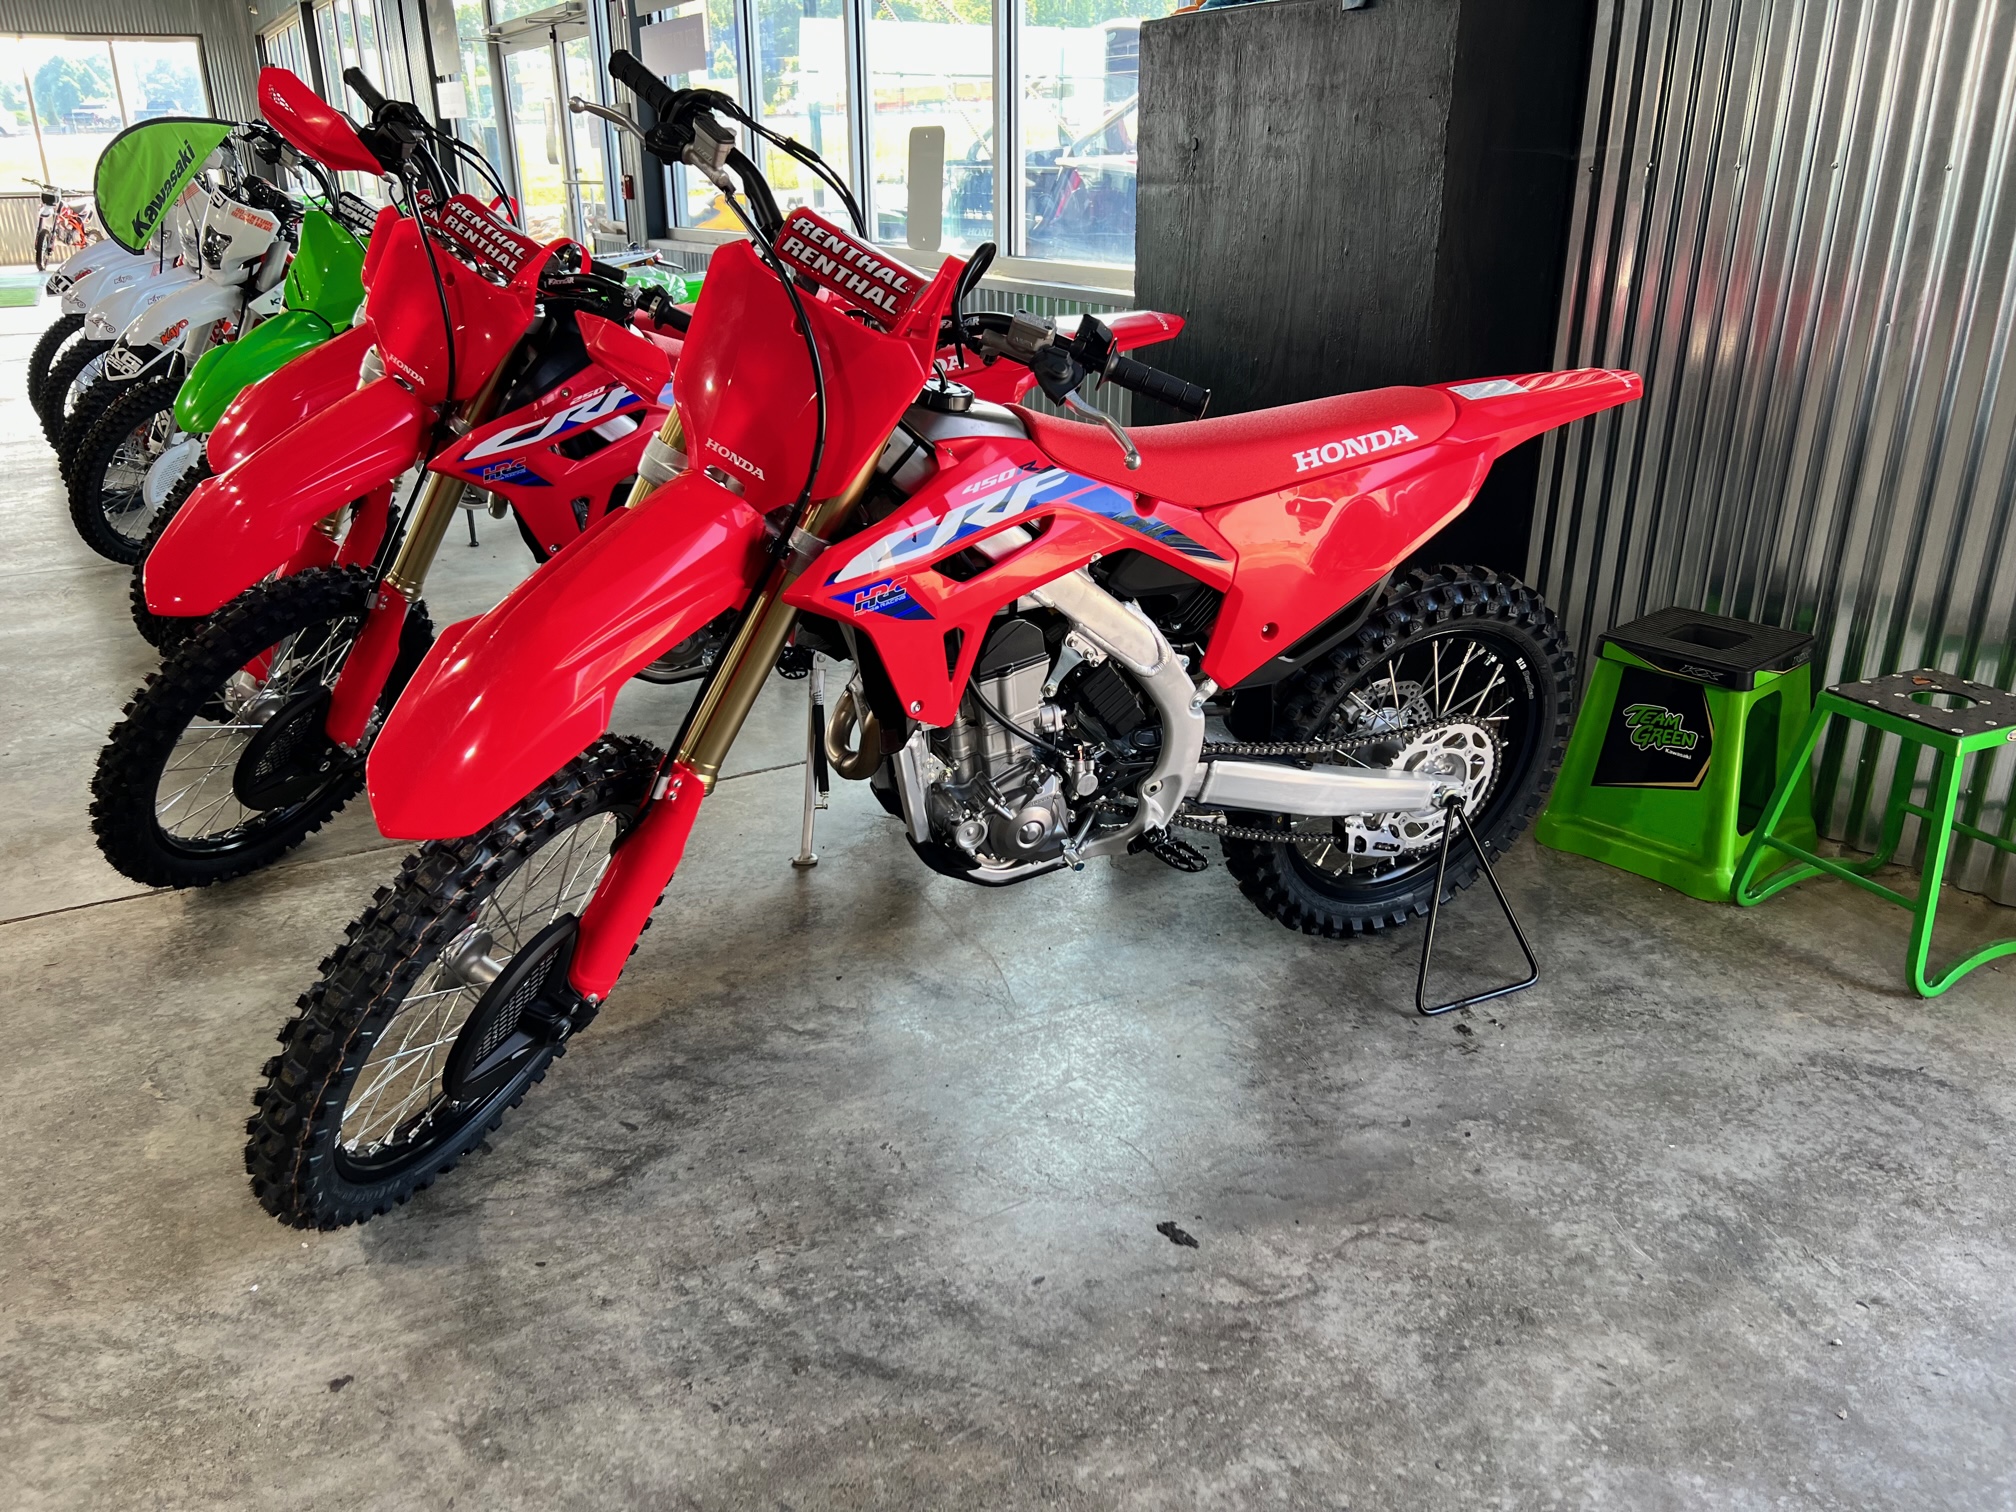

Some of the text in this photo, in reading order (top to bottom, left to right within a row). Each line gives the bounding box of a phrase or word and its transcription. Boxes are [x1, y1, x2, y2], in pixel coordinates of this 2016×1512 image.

[131, 139, 196, 238] Kawasaki
[443, 215, 518, 273] RENTHAL
[450, 202, 526, 260] RENTHAL
[782, 236, 898, 315] RENTHAL
[792, 216, 910, 294] RENTHAL
[159, 318, 189, 346] KAYO
[389, 353, 426, 386] HONDA
[705, 437, 766, 481] HONDA
[1292, 424, 1418, 473] HONDA
[834, 467, 1070, 584] CRF
[854, 575, 908, 613] HRC
[1679, 664, 1725, 682] KX
[1624, 704, 1684, 731] TEAM
[1631, 723, 1698, 750] GREEN
[1665, 748, 1692, 760] Kawasaki
